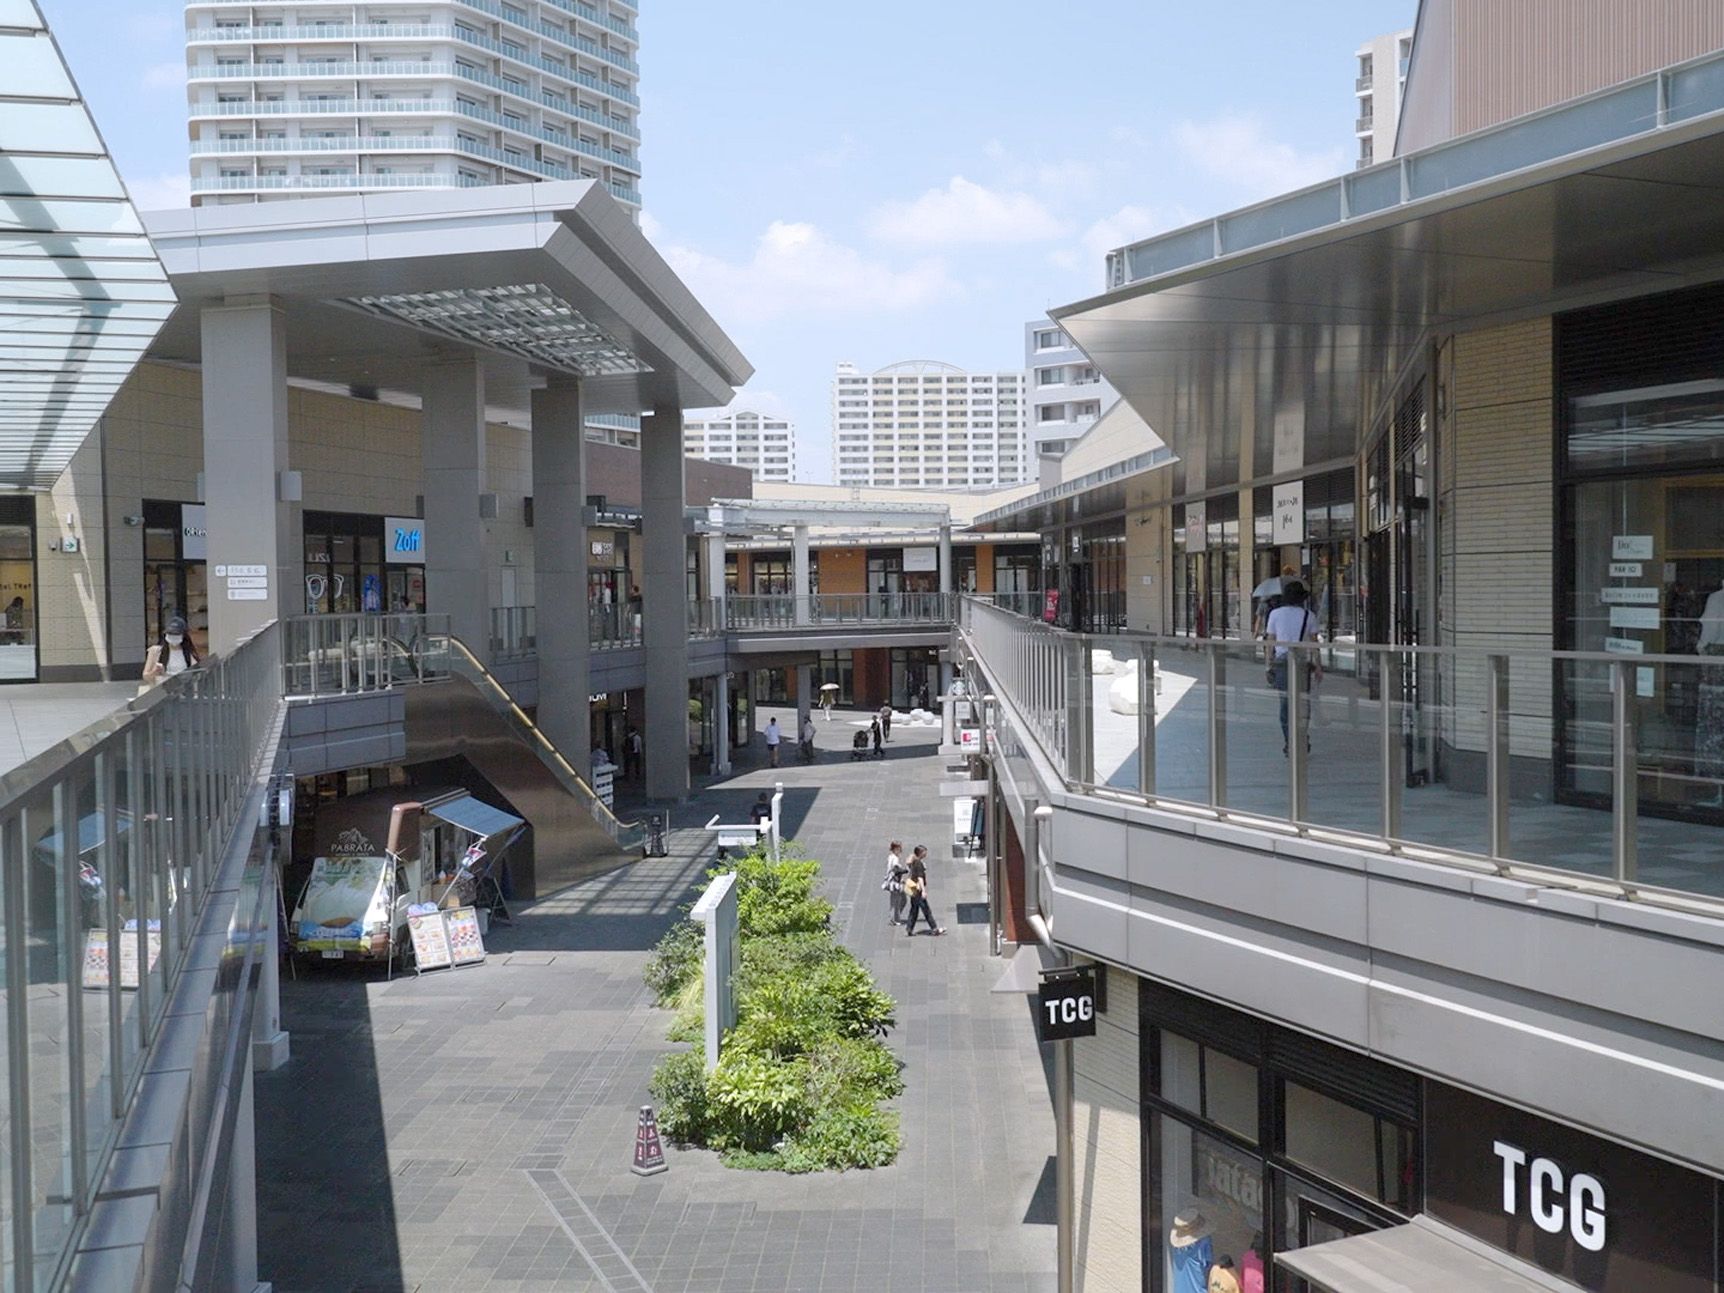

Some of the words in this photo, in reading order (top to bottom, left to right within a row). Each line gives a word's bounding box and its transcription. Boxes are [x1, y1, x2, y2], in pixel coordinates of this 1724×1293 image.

[394, 527, 420, 552] Zoff
[1045, 995, 1093, 1025] TCG
[1493, 1139, 1606, 1252] TCG
